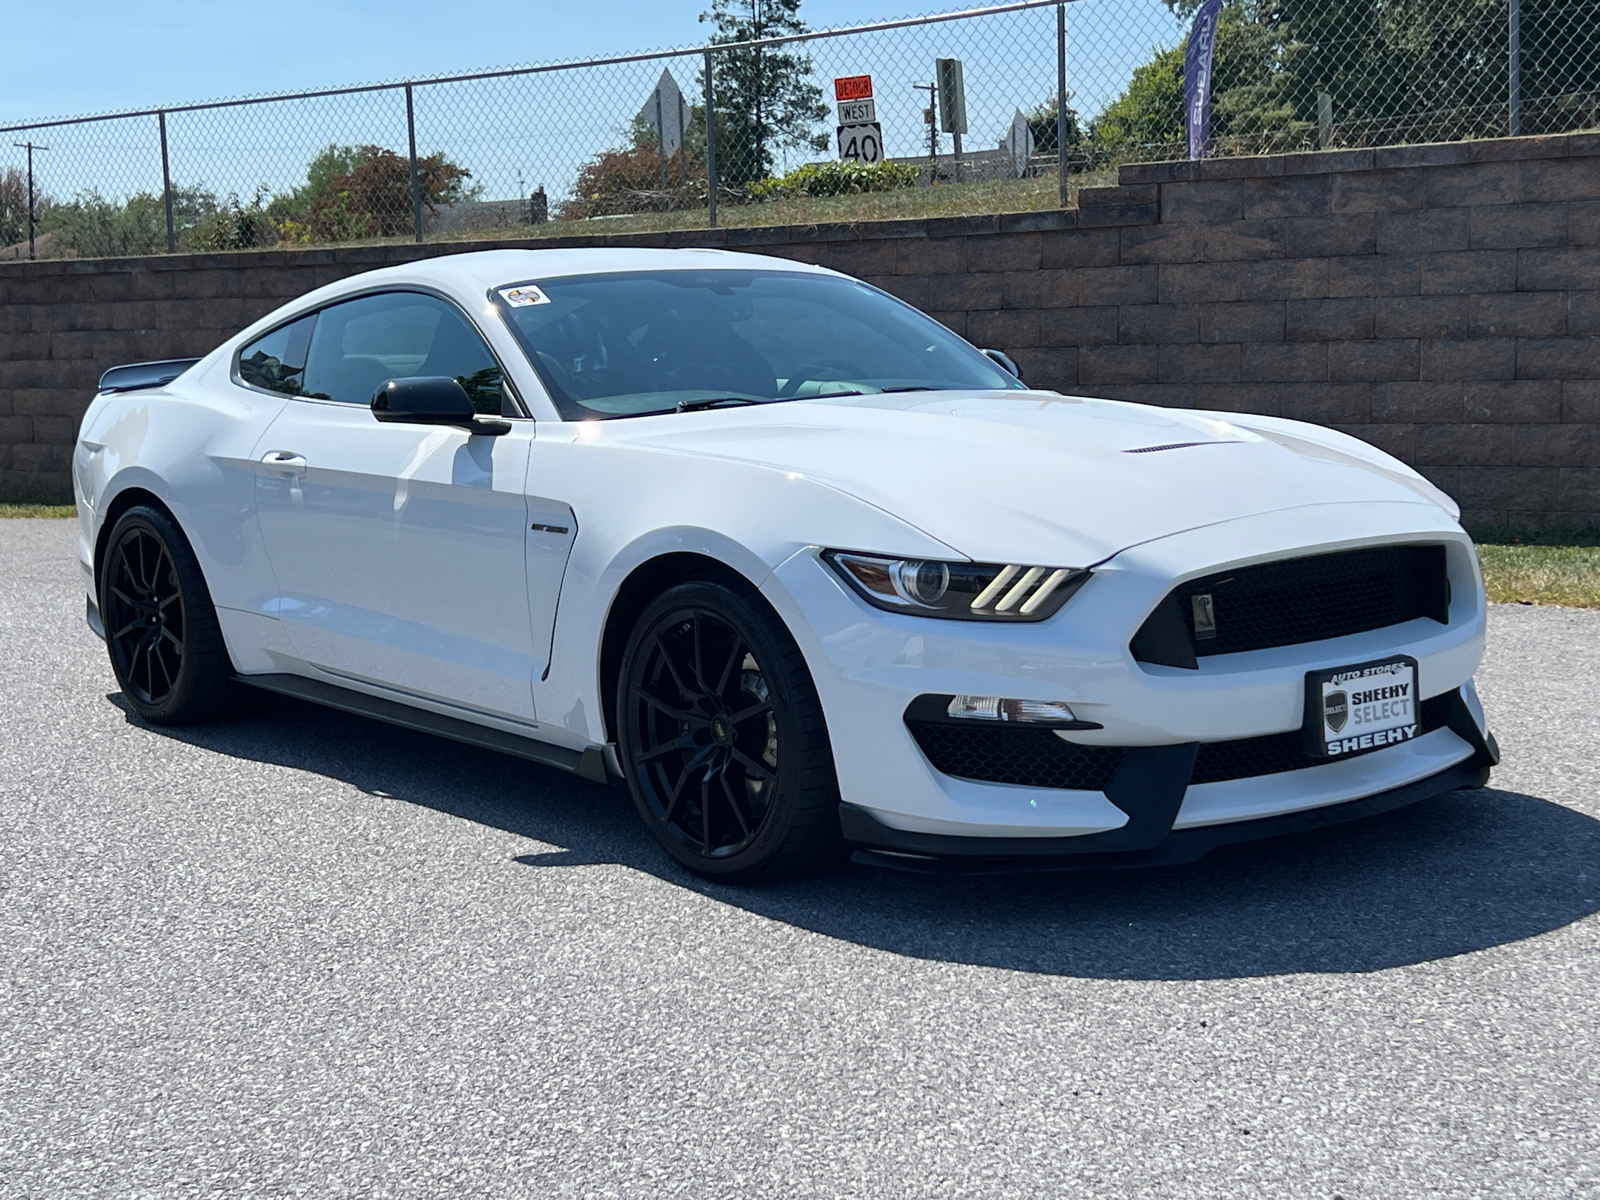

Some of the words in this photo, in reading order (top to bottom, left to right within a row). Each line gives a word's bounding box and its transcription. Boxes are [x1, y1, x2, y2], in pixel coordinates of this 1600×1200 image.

[1193, 14, 1211, 126] SUBARU
[838, 80, 870, 96] DETOUR
[843, 104, 870, 120] WEST
[844, 135, 878, 163] 40
[1331, 670, 1361, 683] AUTO
[1363, 662, 1406, 676] STORES
[1352, 683, 1409, 705] SHEEHY
[1354, 698, 1410, 725] SELECT
[1327, 724, 1417, 755] SHEEHY
